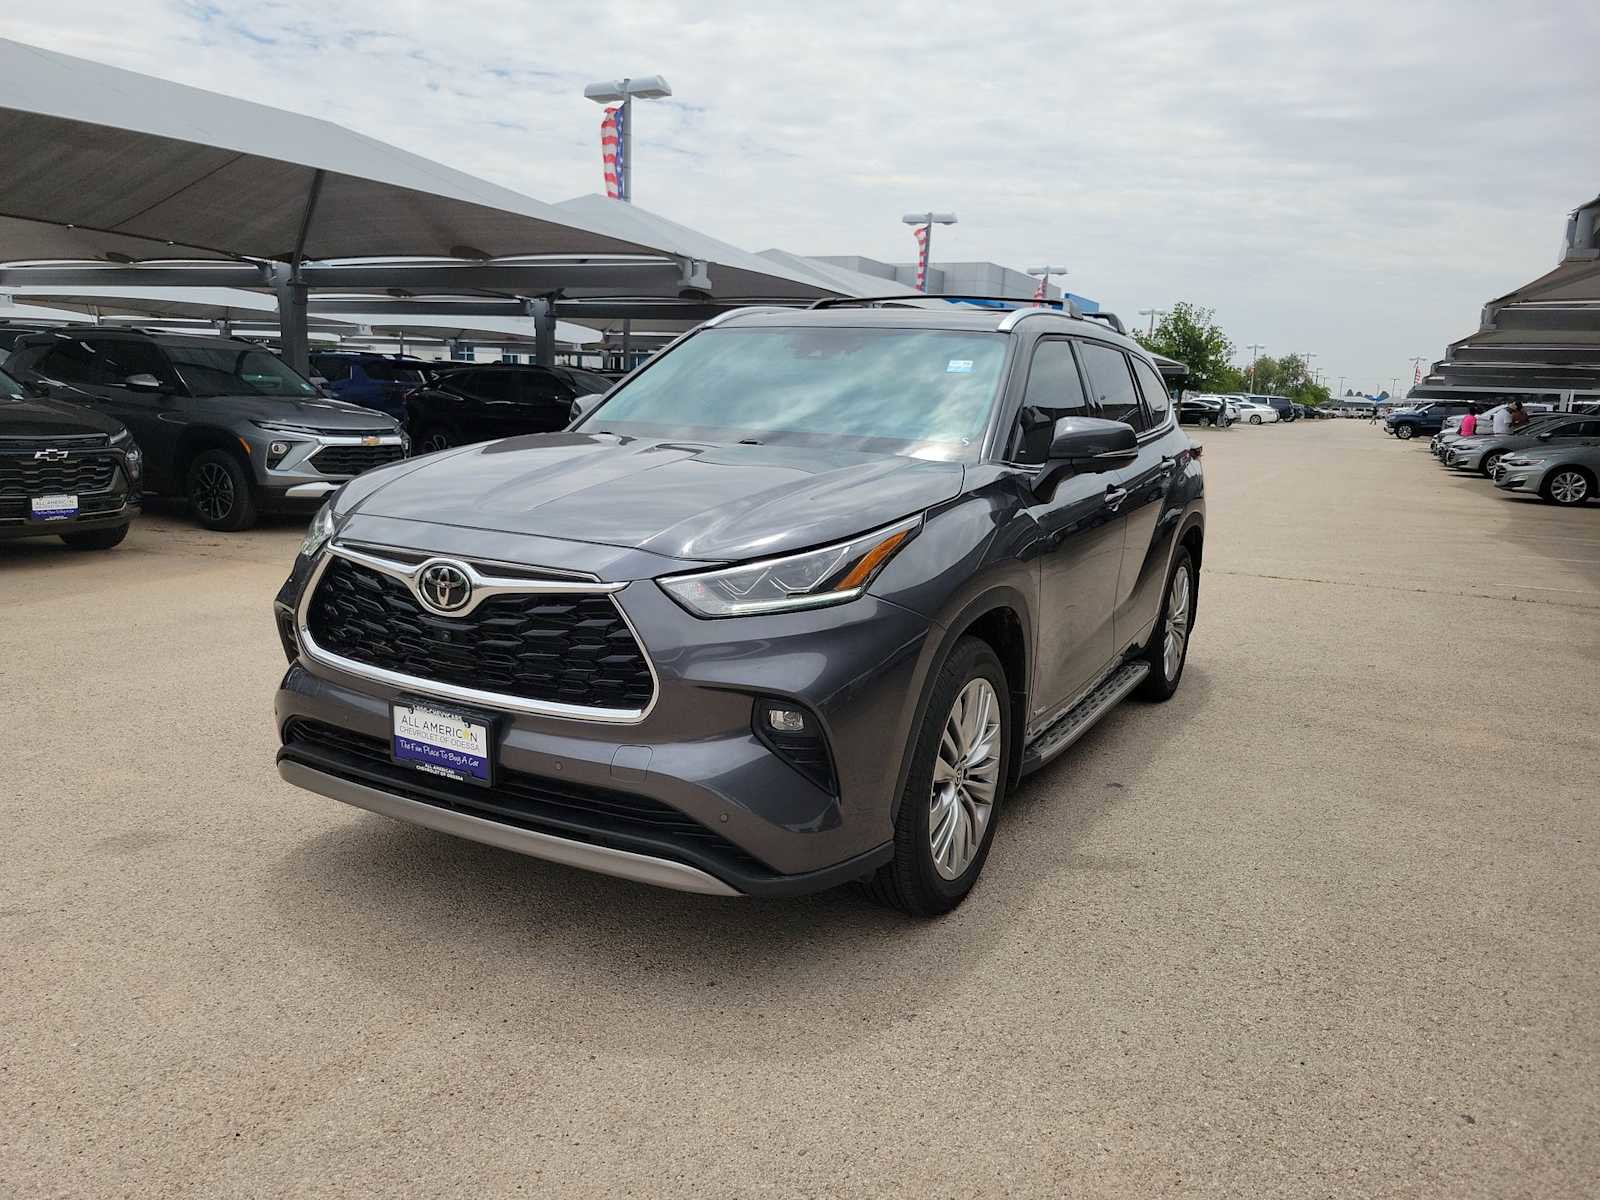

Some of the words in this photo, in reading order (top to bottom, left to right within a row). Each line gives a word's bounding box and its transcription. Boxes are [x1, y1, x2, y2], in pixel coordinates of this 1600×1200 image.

[401, 715, 420, 728] ALL
[399, 726, 439, 742] CHEVROLET
[440, 736, 449, 744] OF
[450, 739, 480, 752] ODESSA
[400, 740, 411, 750] The
[411, 743, 422, 753] Fun
[423, 745, 440, 757] Place
[440, 750, 448, 759] To
[448, 753, 461, 765] Buy
[462, 757, 468, 765] A
[468, 758, 480, 767] Car
